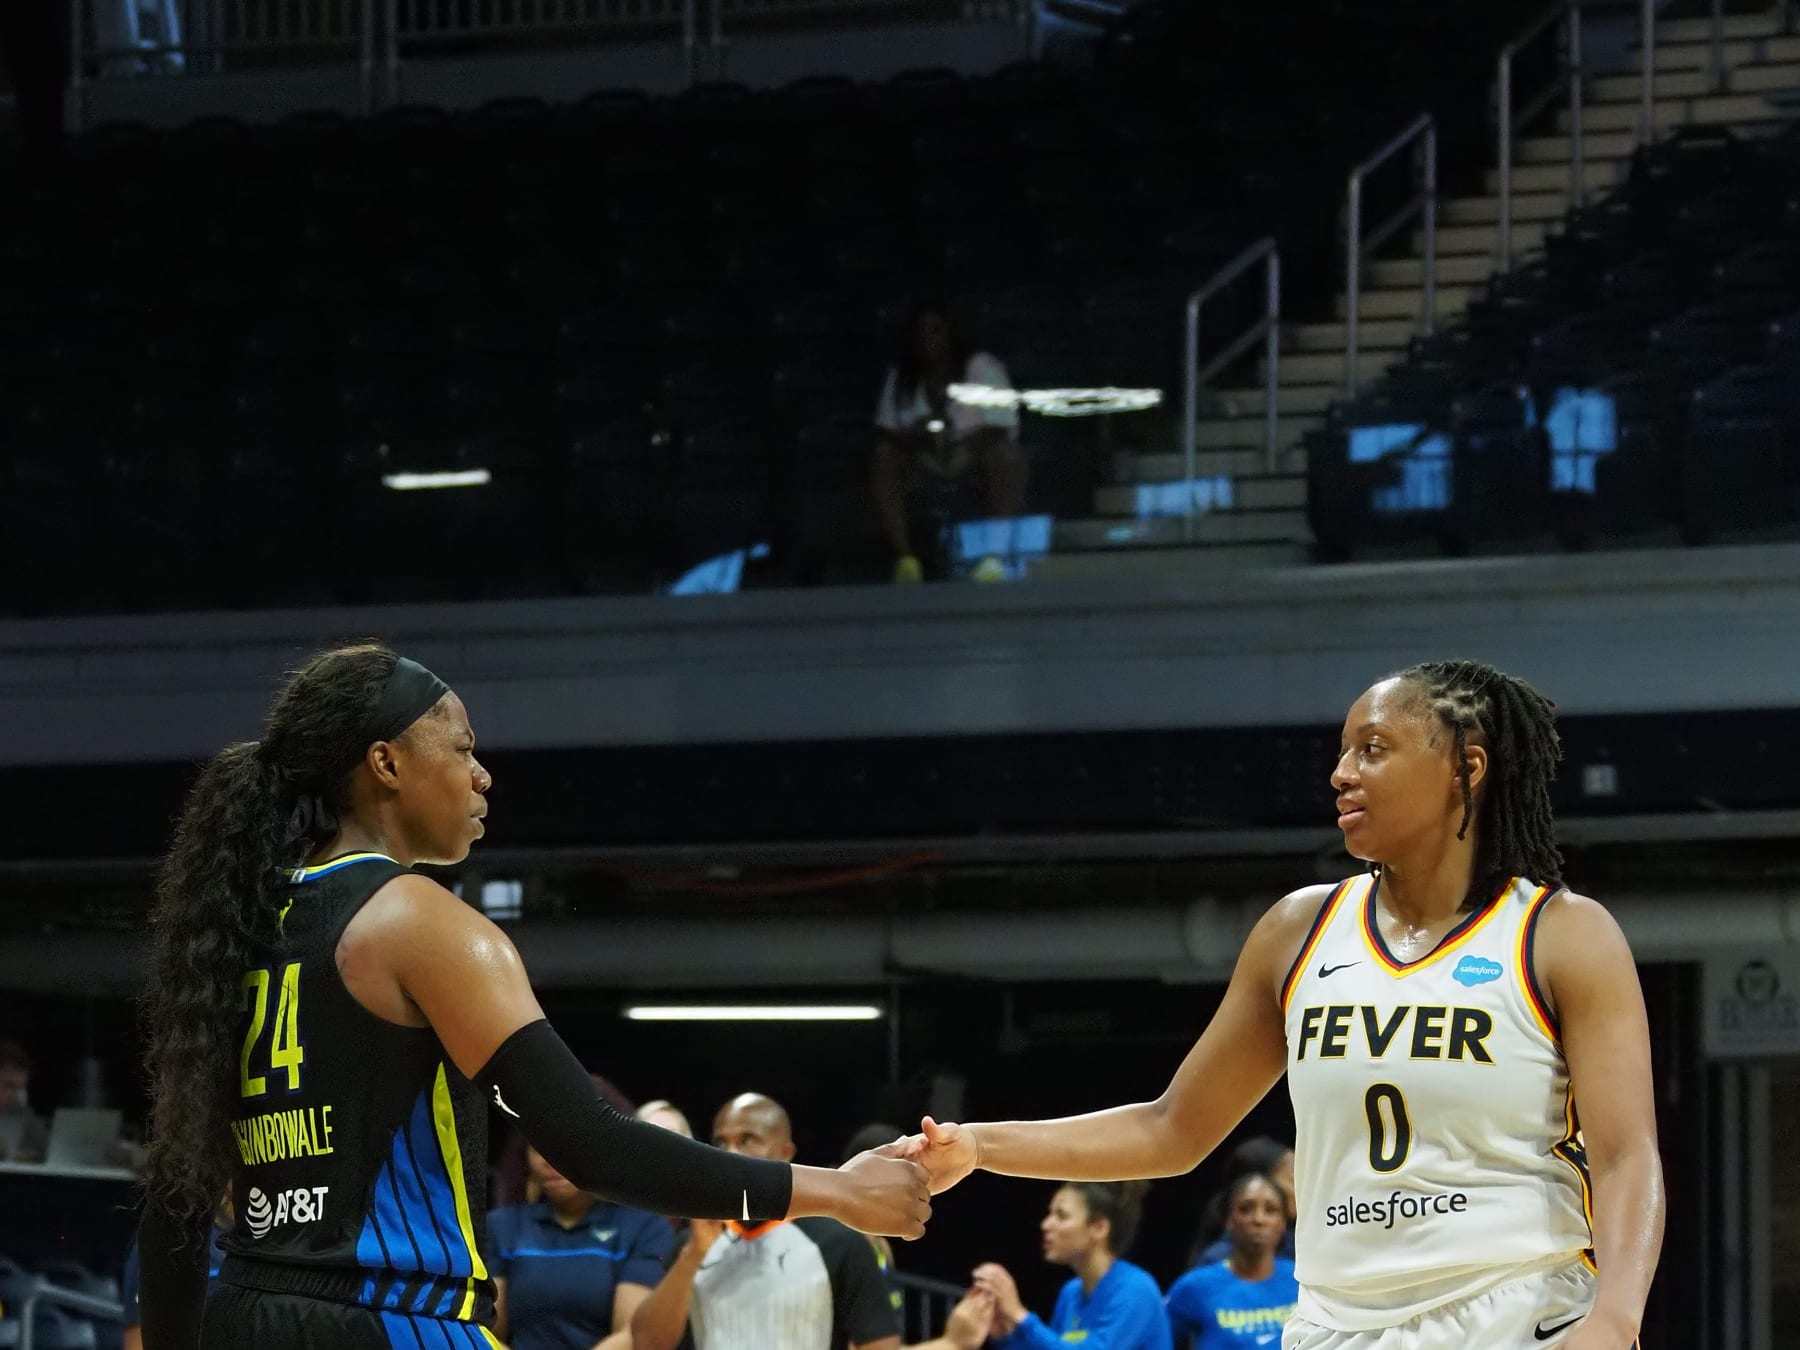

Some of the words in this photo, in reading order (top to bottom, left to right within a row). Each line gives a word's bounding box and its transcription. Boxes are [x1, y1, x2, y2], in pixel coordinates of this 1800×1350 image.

[241, 962, 304, 1097] 24
[1297, 1005, 1496, 1065] FEVER
[1365, 1082, 1412, 1174] 0
[273, 1186, 329, 1227] AT&T
[1326, 1192, 1468, 1229] salesforce
